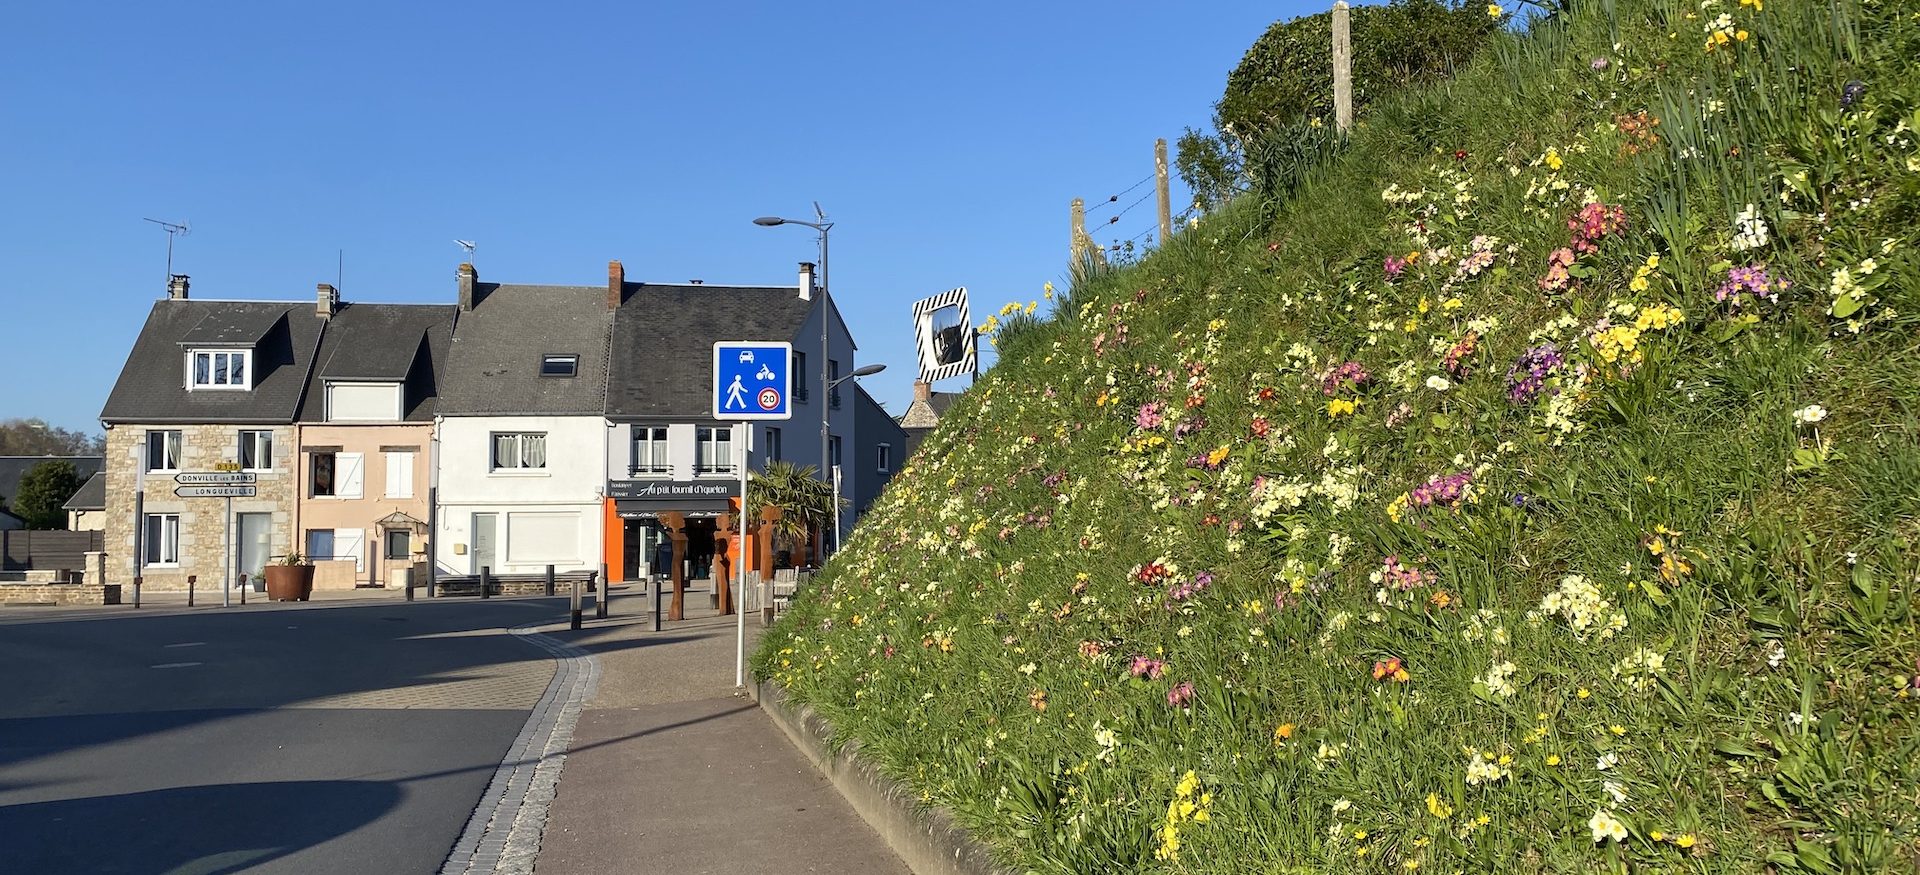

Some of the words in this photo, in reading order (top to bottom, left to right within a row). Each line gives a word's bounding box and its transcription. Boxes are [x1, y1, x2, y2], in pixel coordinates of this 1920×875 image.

[763, 395, 775, 403] 20
[636, 482, 656, 497] Au
[671, 485, 693, 494] fournil
